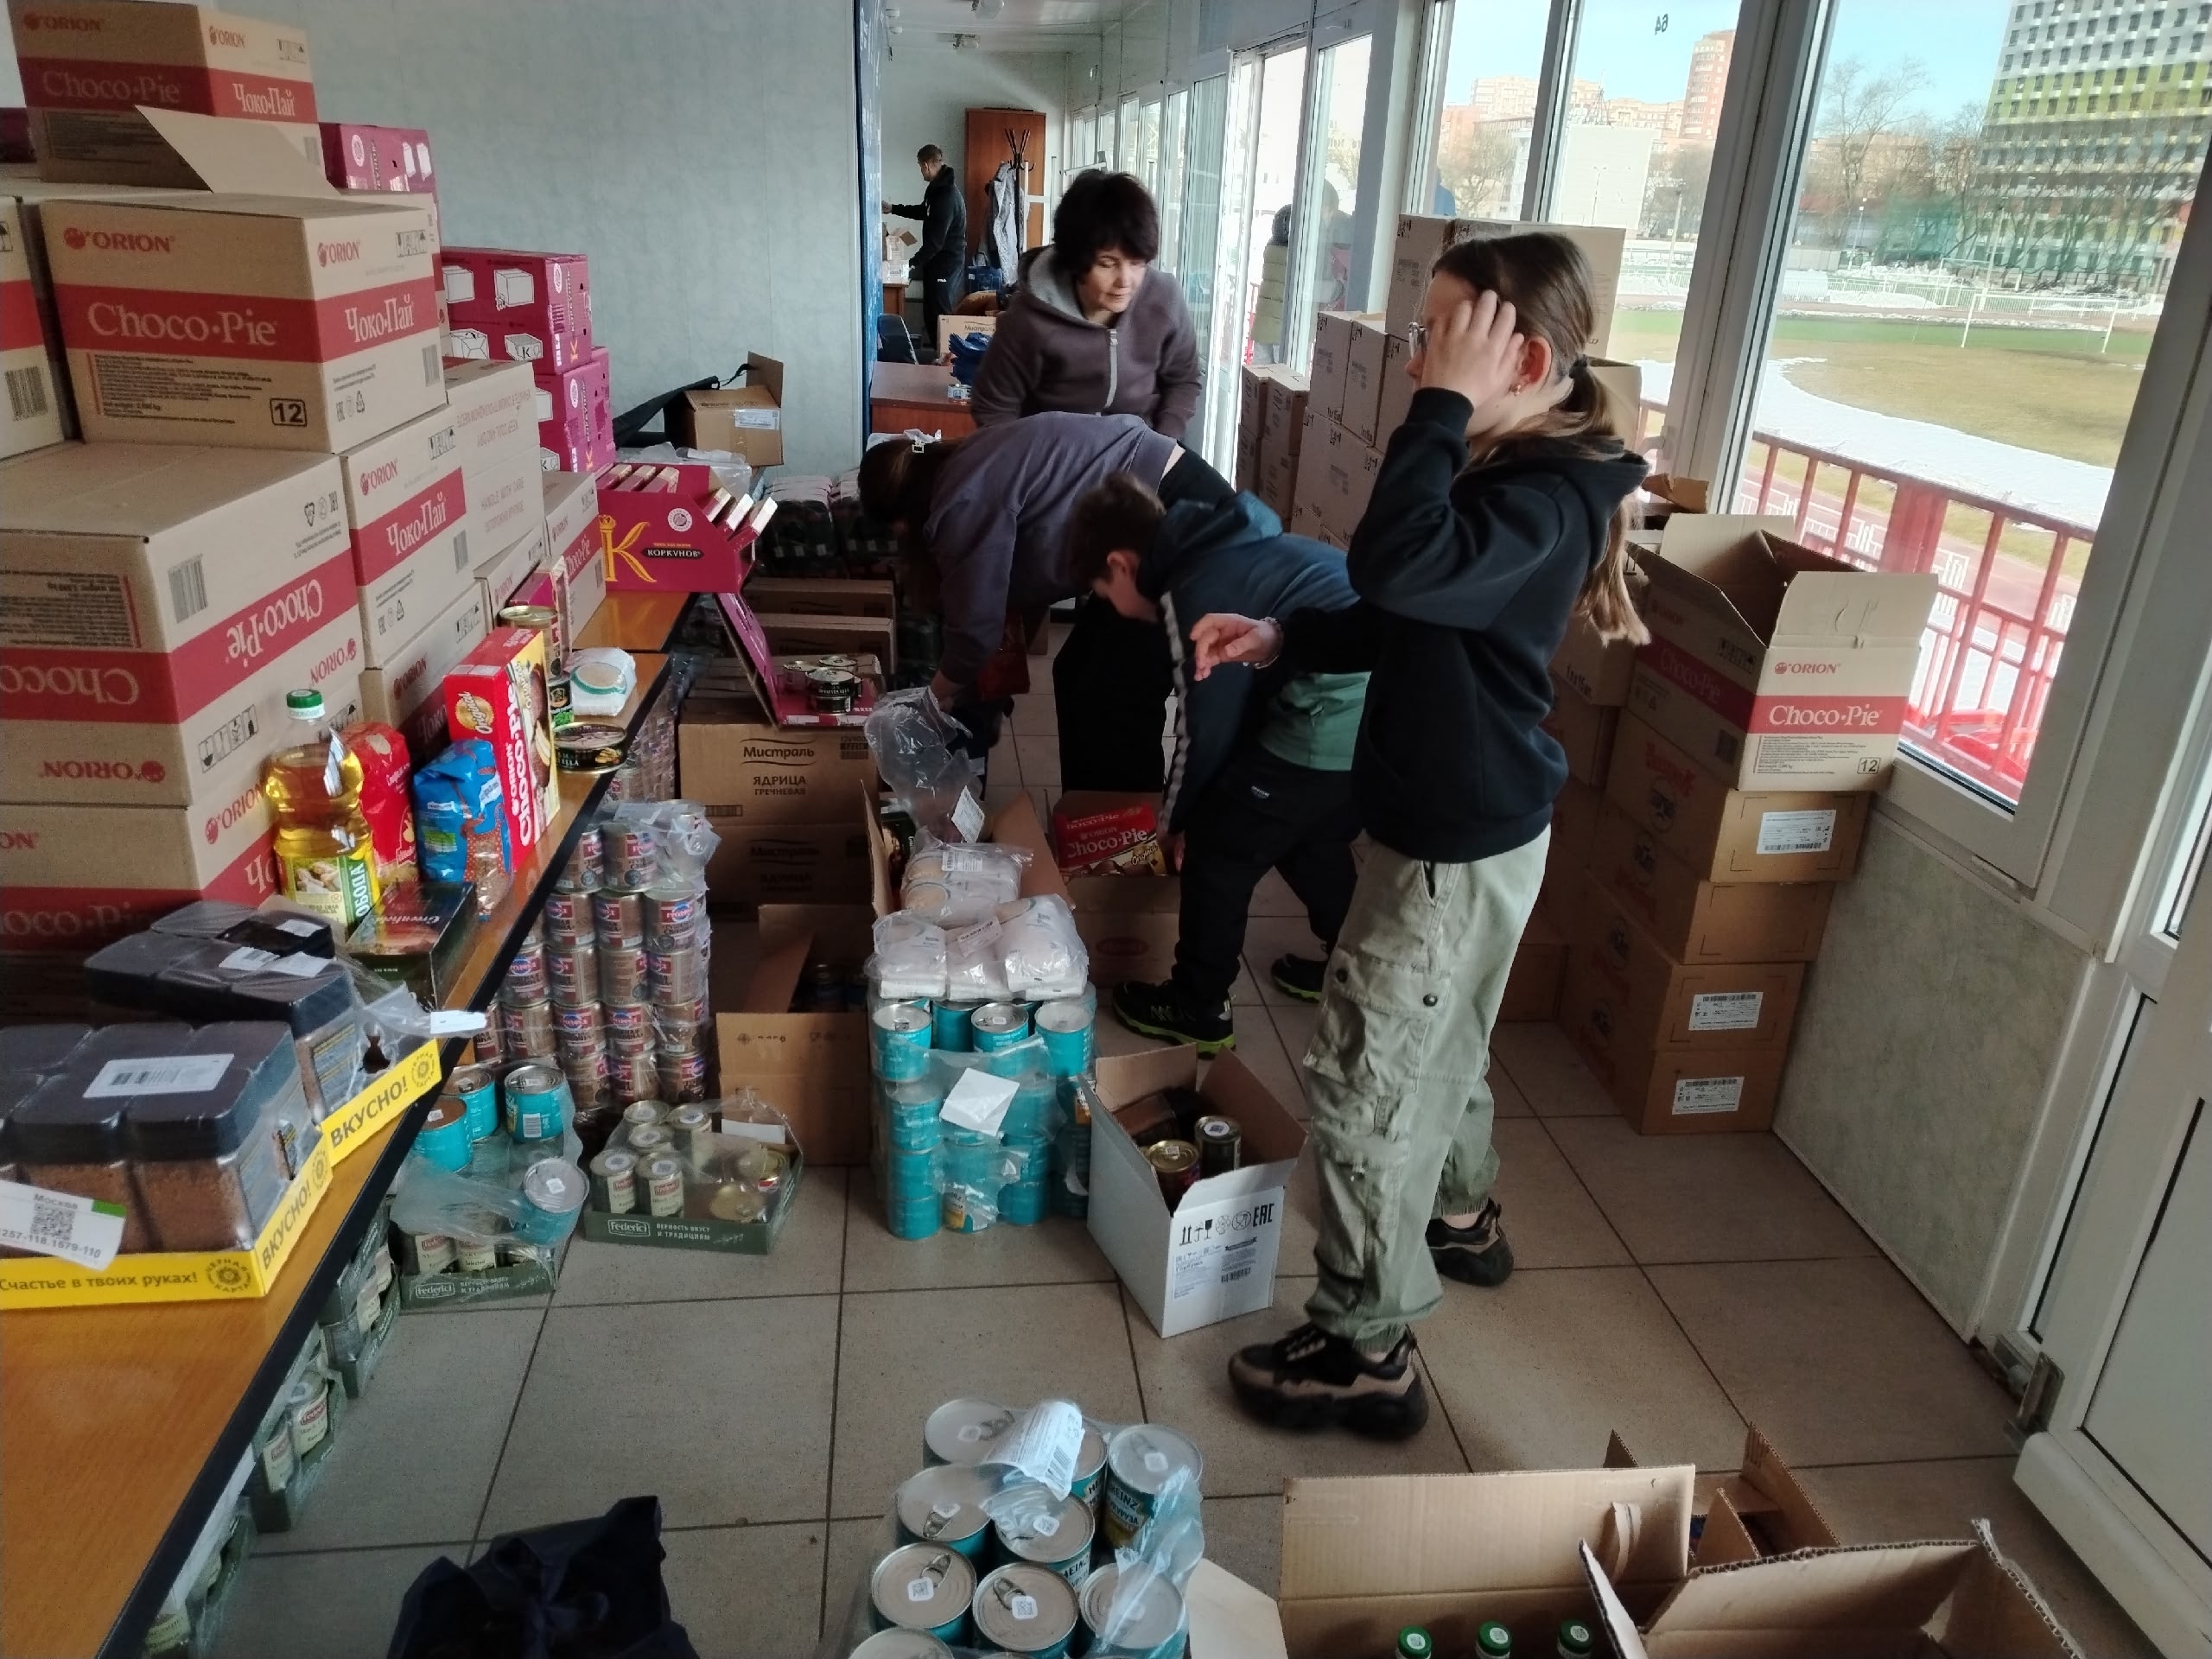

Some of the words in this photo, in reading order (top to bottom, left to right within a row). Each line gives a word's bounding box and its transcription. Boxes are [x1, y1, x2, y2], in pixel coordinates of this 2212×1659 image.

[43, 15, 103, 32] ORION
[217, 29, 246, 48] ORION
[91, 230, 171, 253] ORION
[329, 241, 360, 264] ORION
[274, 403, 302, 423] 12
[371, 461, 398, 490] ORION
[310, 650, 346, 687] ORION
[1790, 663, 1837, 674] ORION
[743, 746, 815, 760] Мистраль
[43, 760, 133, 780] ORION
[505, 742, 518, 799] ORION
[1860, 759, 1878, 772] 12
[753, 775, 806, 786] ЯДРИЦА
[330, 1076, 409, 1148] ВКУСНО!
[34, 1193, 79, 1210] Москва
[263, 1180, 312, 1271] ВКУСНО!
[1252, 1203, 1275, 1228] EAC
[610, 1219, 648, 1233] Federici
[0, 1278, 66, 1292] Счастье
[72, 1279, 80, 1288] в
[86, 1276, 137, 1287] твоих
[143, 1271, 198, 1287] руках!
